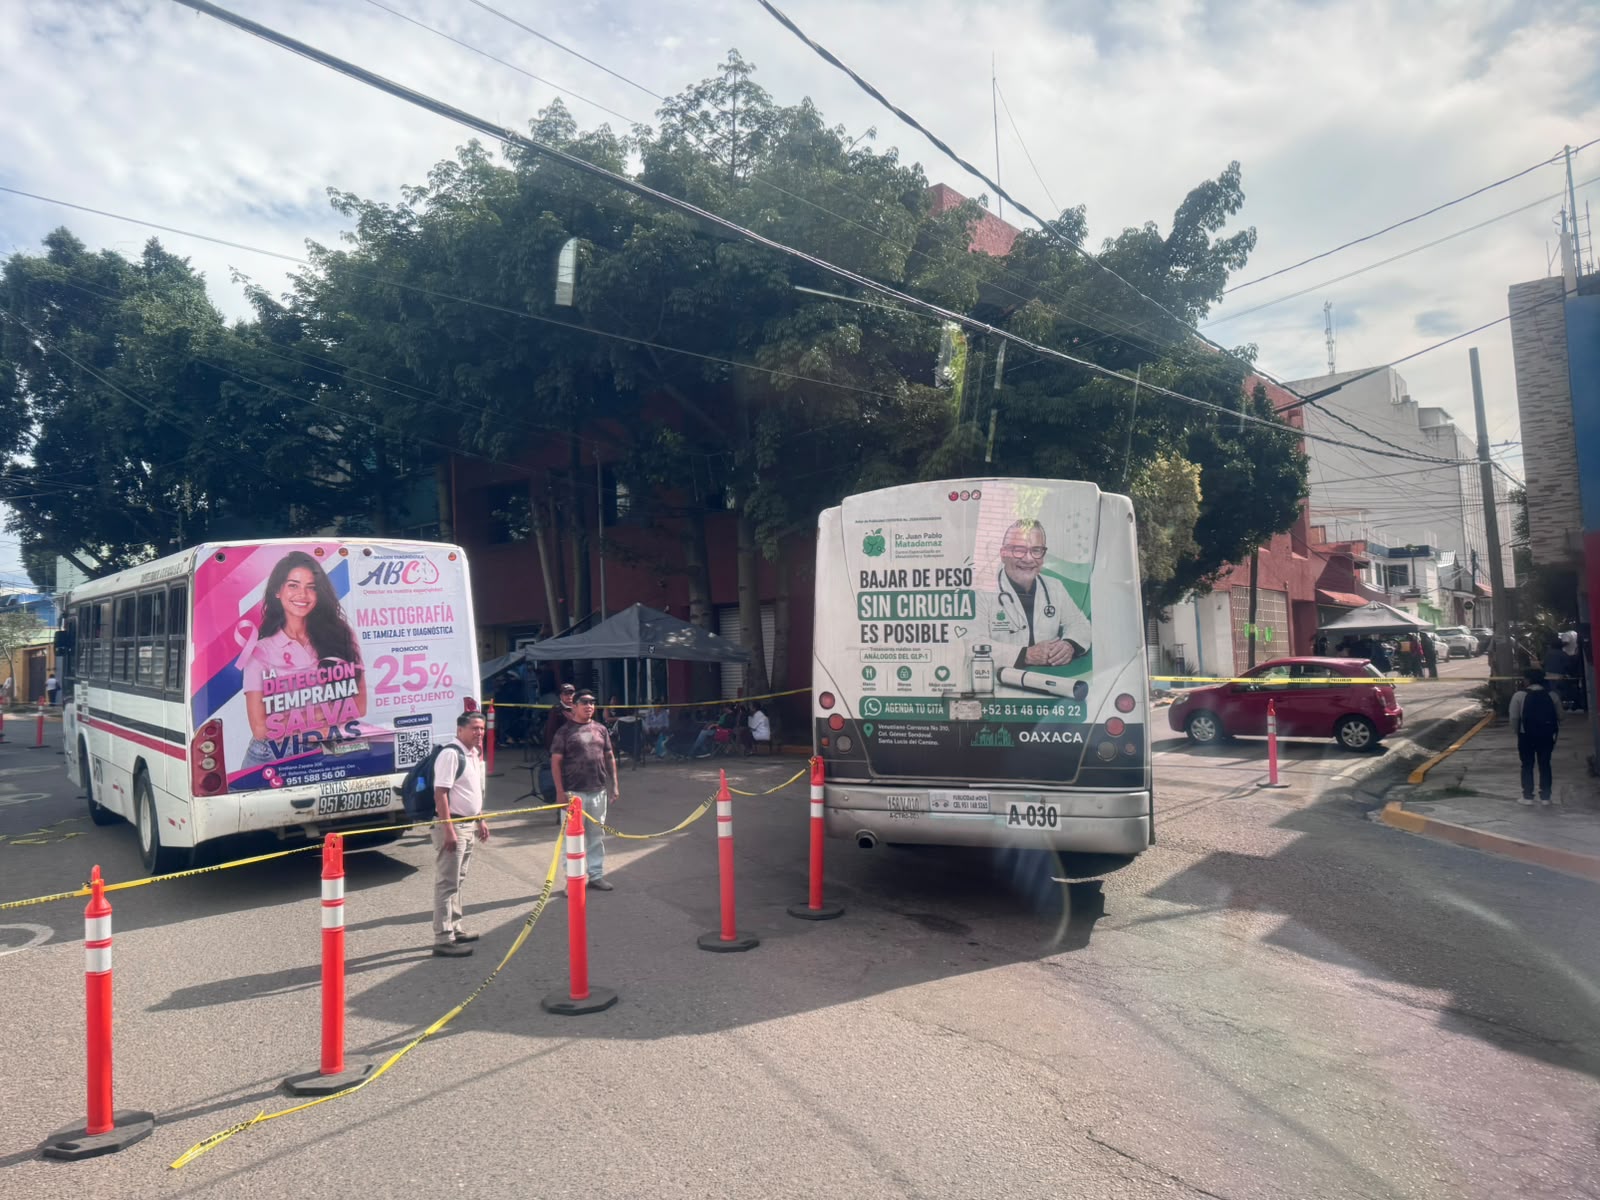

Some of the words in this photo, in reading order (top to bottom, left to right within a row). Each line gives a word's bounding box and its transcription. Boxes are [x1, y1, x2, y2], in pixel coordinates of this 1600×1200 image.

[895, 540, 943, 548] Matadamaz
[357, 560, 422, 586] ABC
[860, 569, 907, 588] BAJAR
[912, 569, 930, 587] DE
[935, 568, 972, 587] PESO
[861, 594, 891, 618] SIN
[897, 588, 973, 617] CIRUGÍA
[356, 601, 455, 627] MASTOGRAFÍA
[362, 631, 371, 640] DE
[373, 628, 405, 639] TAMIZAJE
[407, 628, 412, 637] Y
[413, 625, 453, 637] DIAGNÓSTICA
[860, 624, 879, 643] ES
[883, 623, 949, 643] POSIBLE
[864, 652, 897, 660] ANÁLOGOS
[262, 668, 277, 680] LA
[263, 661, 356, 695] DETECCIÓN
[373, 653, 453, 694] 25%
[262, 678, 359, 714] TEMPRANA
[375, 697, 391, 707] DE
[393, 690, 455, 705] DESCUENTO
[884, 702, 914, 713] AGENDA
[916, 703, 925, 714] TU
[927, 703, 944, 714] CITA
[982, 704, 1001, 715] +52
[1004, 704, 1017, 715] 81
[1020, 705, 1033, 715] 48
[1036, 705, 1049, 715] 06
[1052, 705, 1064, 716] 46
[1068, 705, 1081, 716] 22
[265, 697, 360, 740] SALVA
[268, 720, 361, 759] VIDAS
[1018, 732, 1083, 743] OAXACA
[286, 777, 302, 785] 951
[304, 775, 320, 783] 588
[322, 772, 333, 780] 56
[334, 770, 346, 778] 00
[320, 781, 349, 796] VENTAS
[320, 796, 338, 814] 951
[340, 793, 361, 811] 380
[363, 789, 391, 809] 9336
[1008, 804, 1057, 828] A-030
